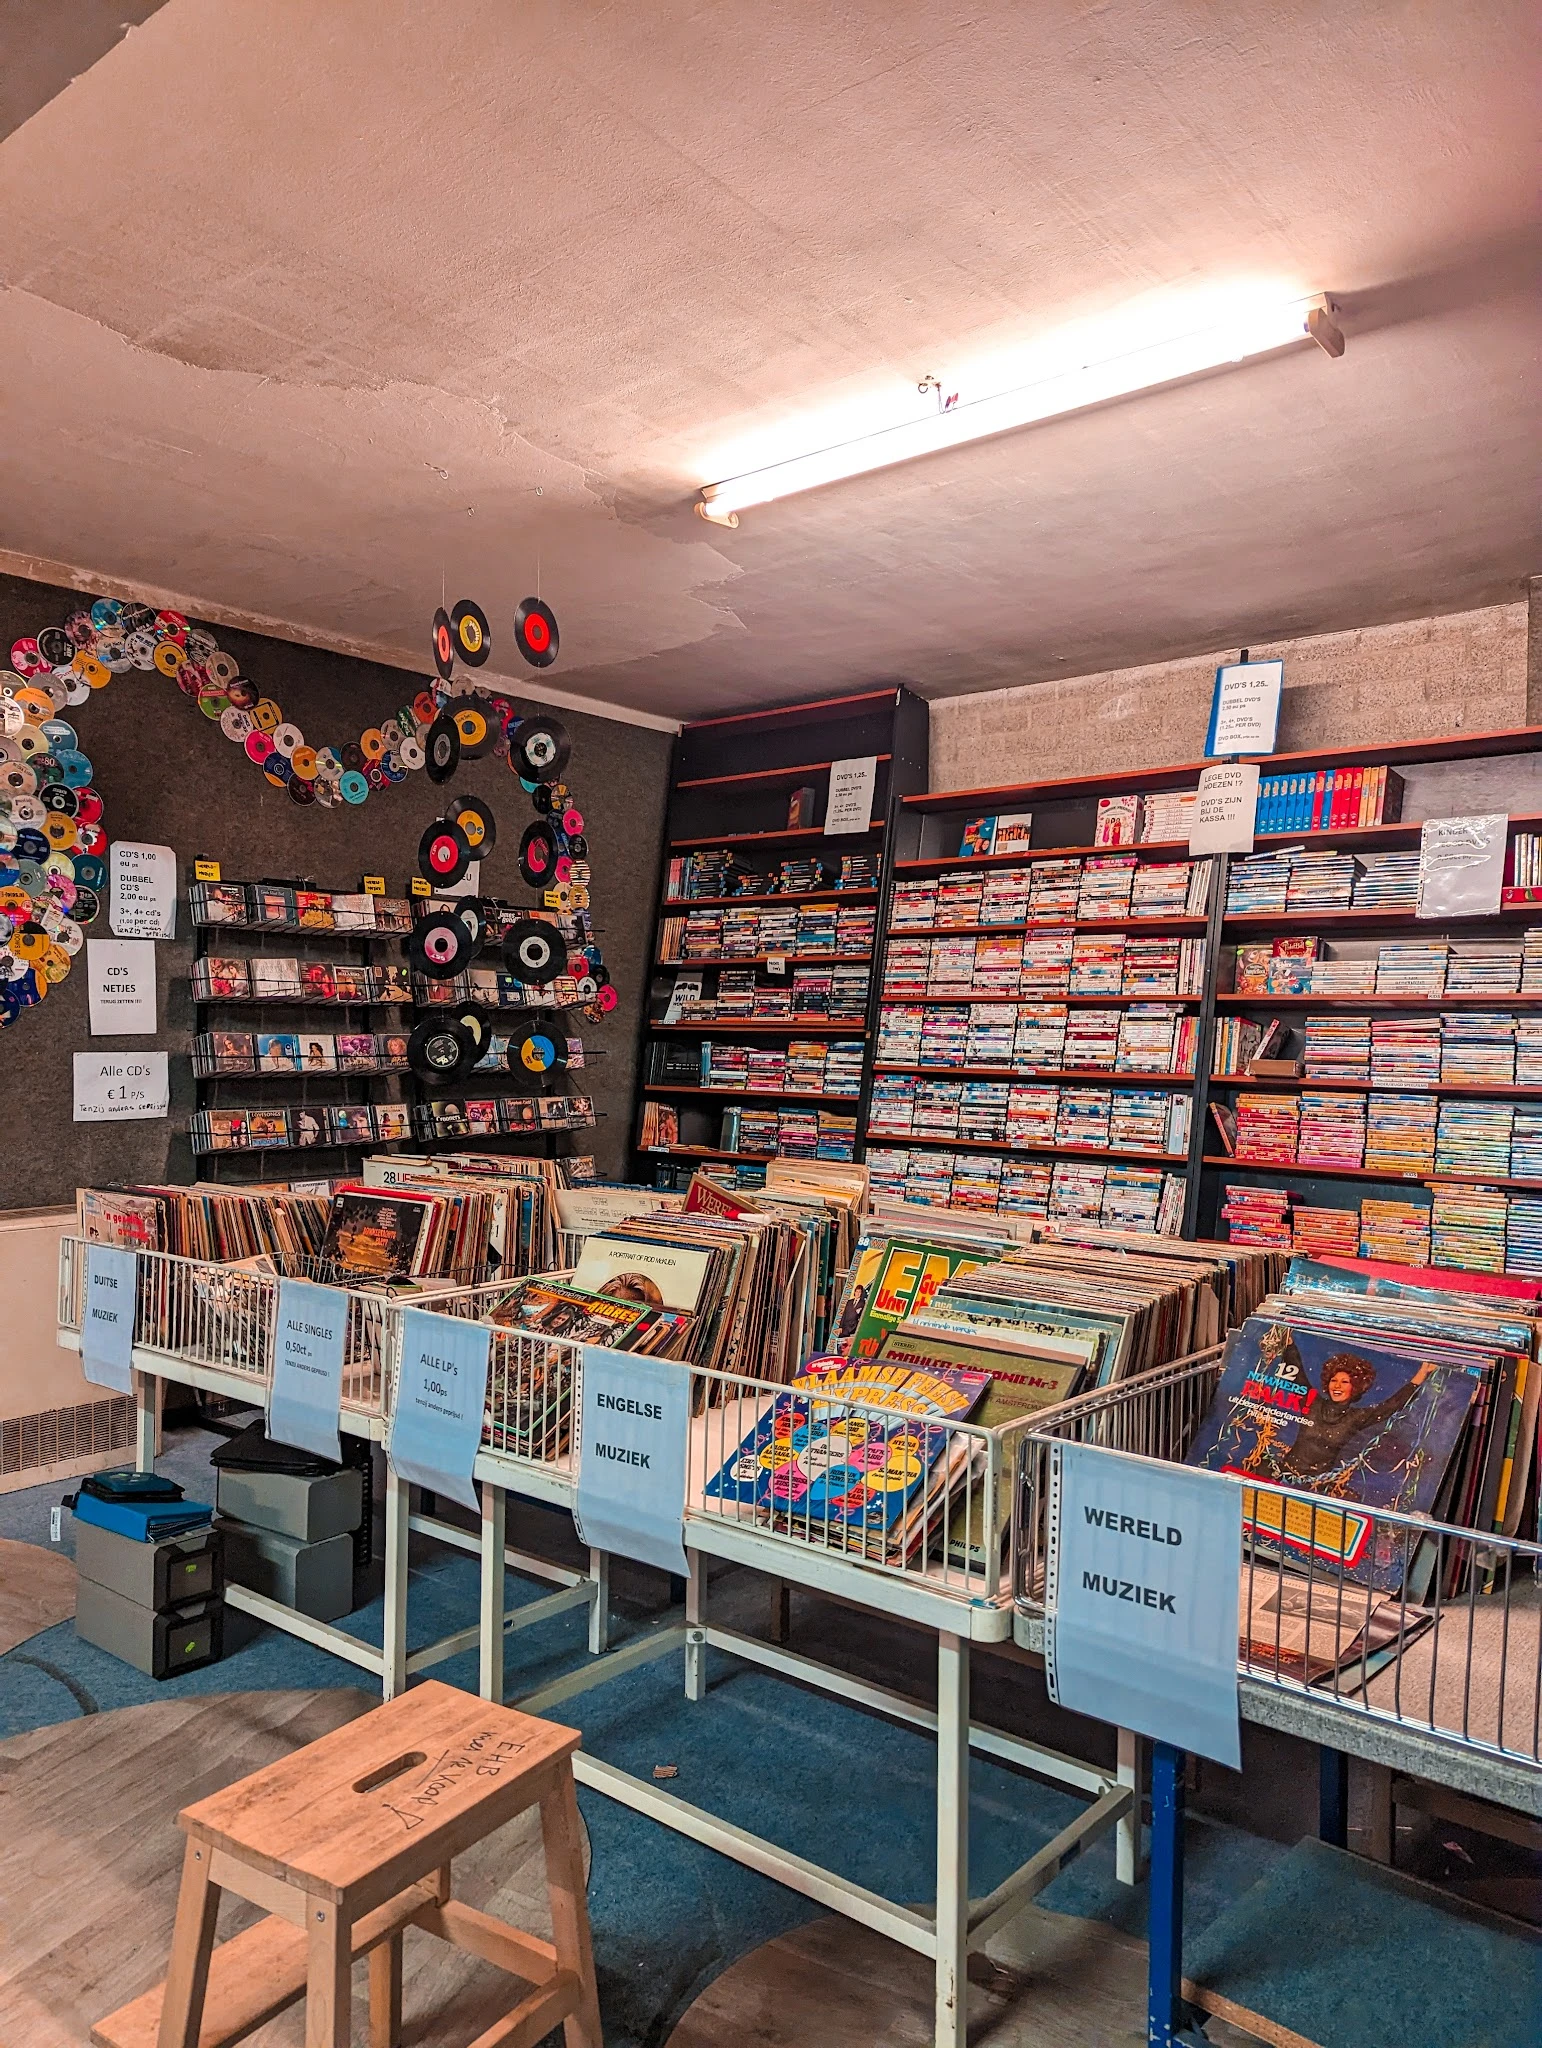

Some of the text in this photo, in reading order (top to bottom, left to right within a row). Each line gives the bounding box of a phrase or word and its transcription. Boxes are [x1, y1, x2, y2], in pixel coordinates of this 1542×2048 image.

[1224, 682, 1248, 691] DVD'S
[1204, 772, 1242, 783] LEGE DVD
[1204, 780, 1234, 791] HOEZEN
[1201, 796, 1242, 808] DVD'S ZIJN
[1200, 806, 1224, 816] BIJ DE
[1200, 814, 1225, 824] KASSA
[120, 850, 139, 859] CD'S
[120, 874, 154, 884] DUBBEL
[120, 884, 140, 892] CD'S
[134, 918, 148, 926] per
[108, 967, 129, 976] CD'S
[102, 984, 136, 993] NETJES
[100, 1066, 150, 1076] Alle CD's
[107, 1089, 115, 1100] €
[119, 1086, 126, 1100] 1
[384, 1171, 396, 1184] 28
[858, 1236, 870, 1246] 88
[614, 1252, 636, 1260] PORTRAIT
[644, 1255, 656, 1264] ROD
[94, 1274, 118, 1290] DUITSE
[92, 1308, 118, 1324] MUZIEK
[286, 1320, 333, 1340] ALLE SINGLES
[285, 1340, 306, 1356] 0,50ct
[894, 1342, 916, 1350] STEREO
[420, 1354, 458, 1376] ALLE LP's
[886, 1350, 952, 1368] MAHLER
[297, 1362, 310, 1372] ANDERS
[1274, 1362, 1300, 1382] 12
[1246, 1370, 1308, 1396] NUMMERS
[904, 1371, 970, 1414] FEEST
[1240, 1380, 1318, 1415] RAAK!
[428, 1402, 442, 1414] anders
[596, 1392, 662, 1420] ENGELSE
[1228, 1396, 1315, 1427] uit deze nederlandse
[595, 1442, 651, 1470] MUZIEK
[1084, 1506, 1183, 1547] WERELD
[1082, 1571, 1177, 1614] MUZIEK
[476, 1741, 526, 1777] EHB
